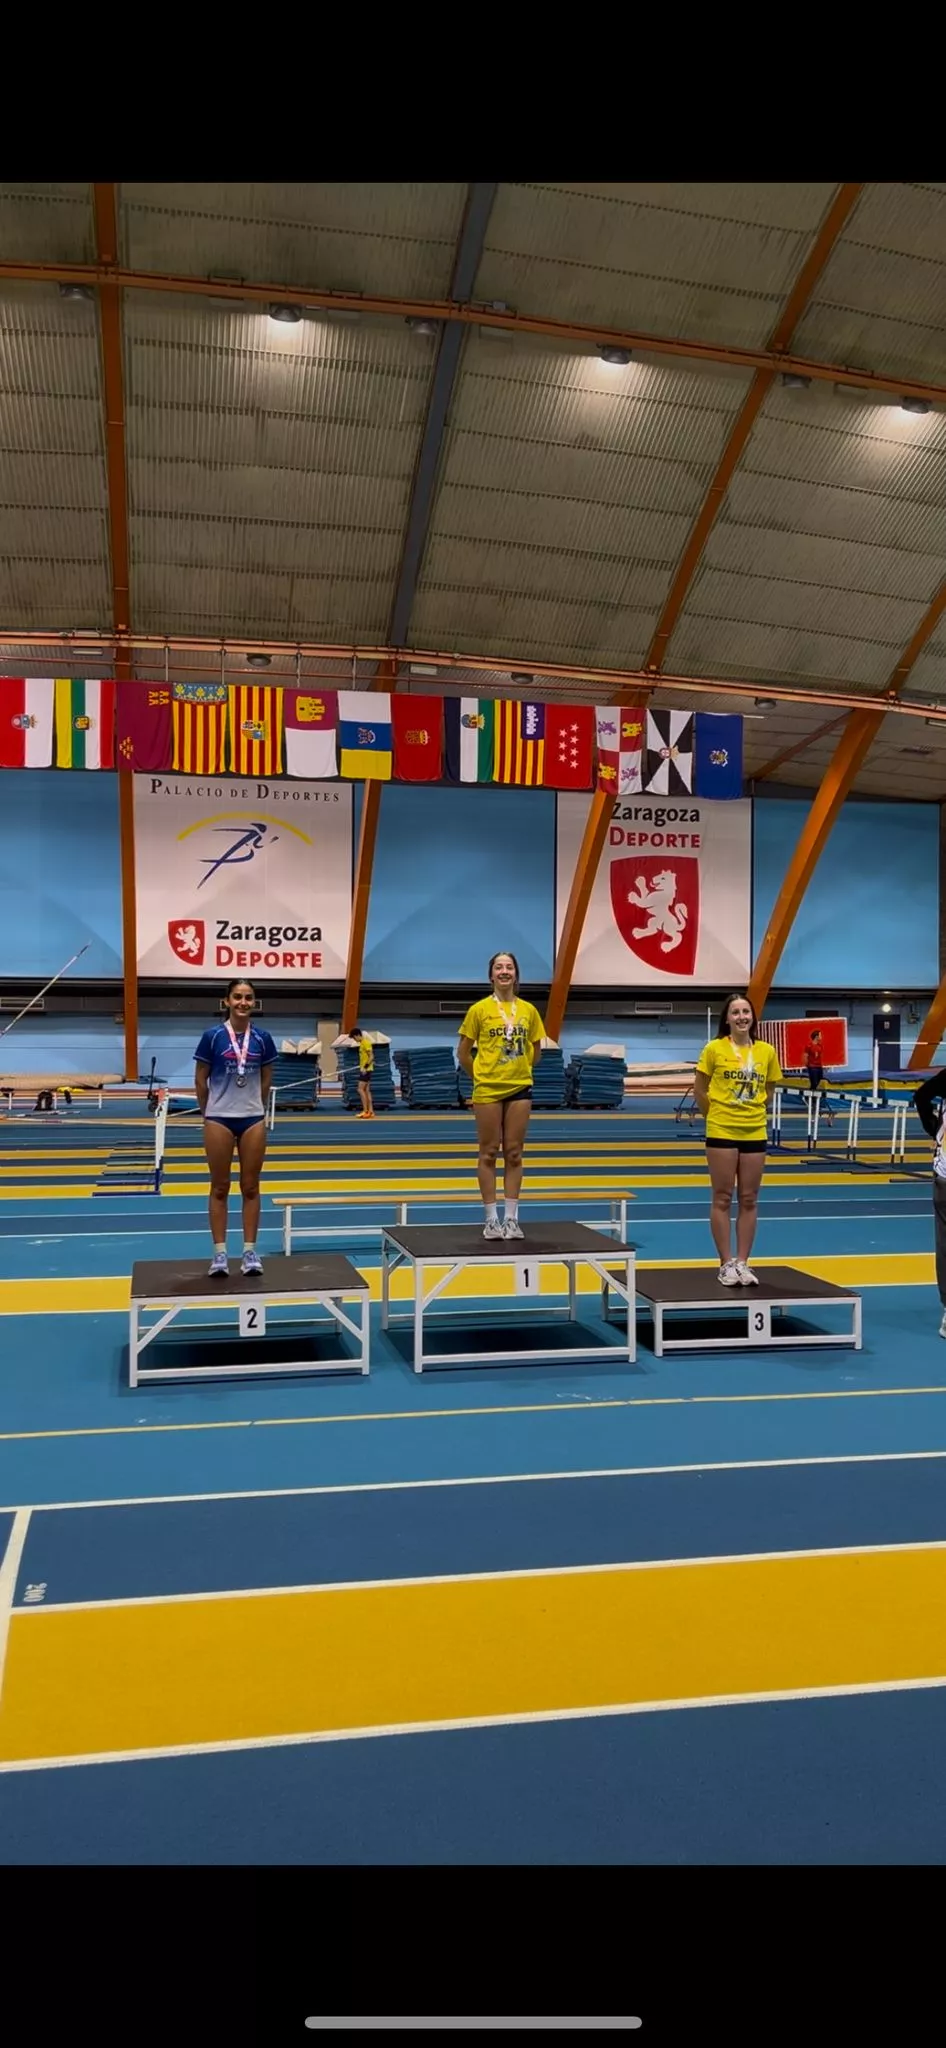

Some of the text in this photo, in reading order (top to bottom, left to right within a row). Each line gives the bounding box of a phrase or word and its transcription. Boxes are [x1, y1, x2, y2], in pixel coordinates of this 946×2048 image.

[150, 778, 340, 802] PALACIO DE DEPORTES
[611, 802, 700, 827] Zaragoza
[609, 826, 701, 848] DEPORTE
[215, 920, 322, 947] Zaragoza
[215, 945, 322, 968] DEPORTE
[523, 1267, 530, 1288] 1
[246, 1307, 259, 1329] 2
[755, 1312, 764, 1331] 3
